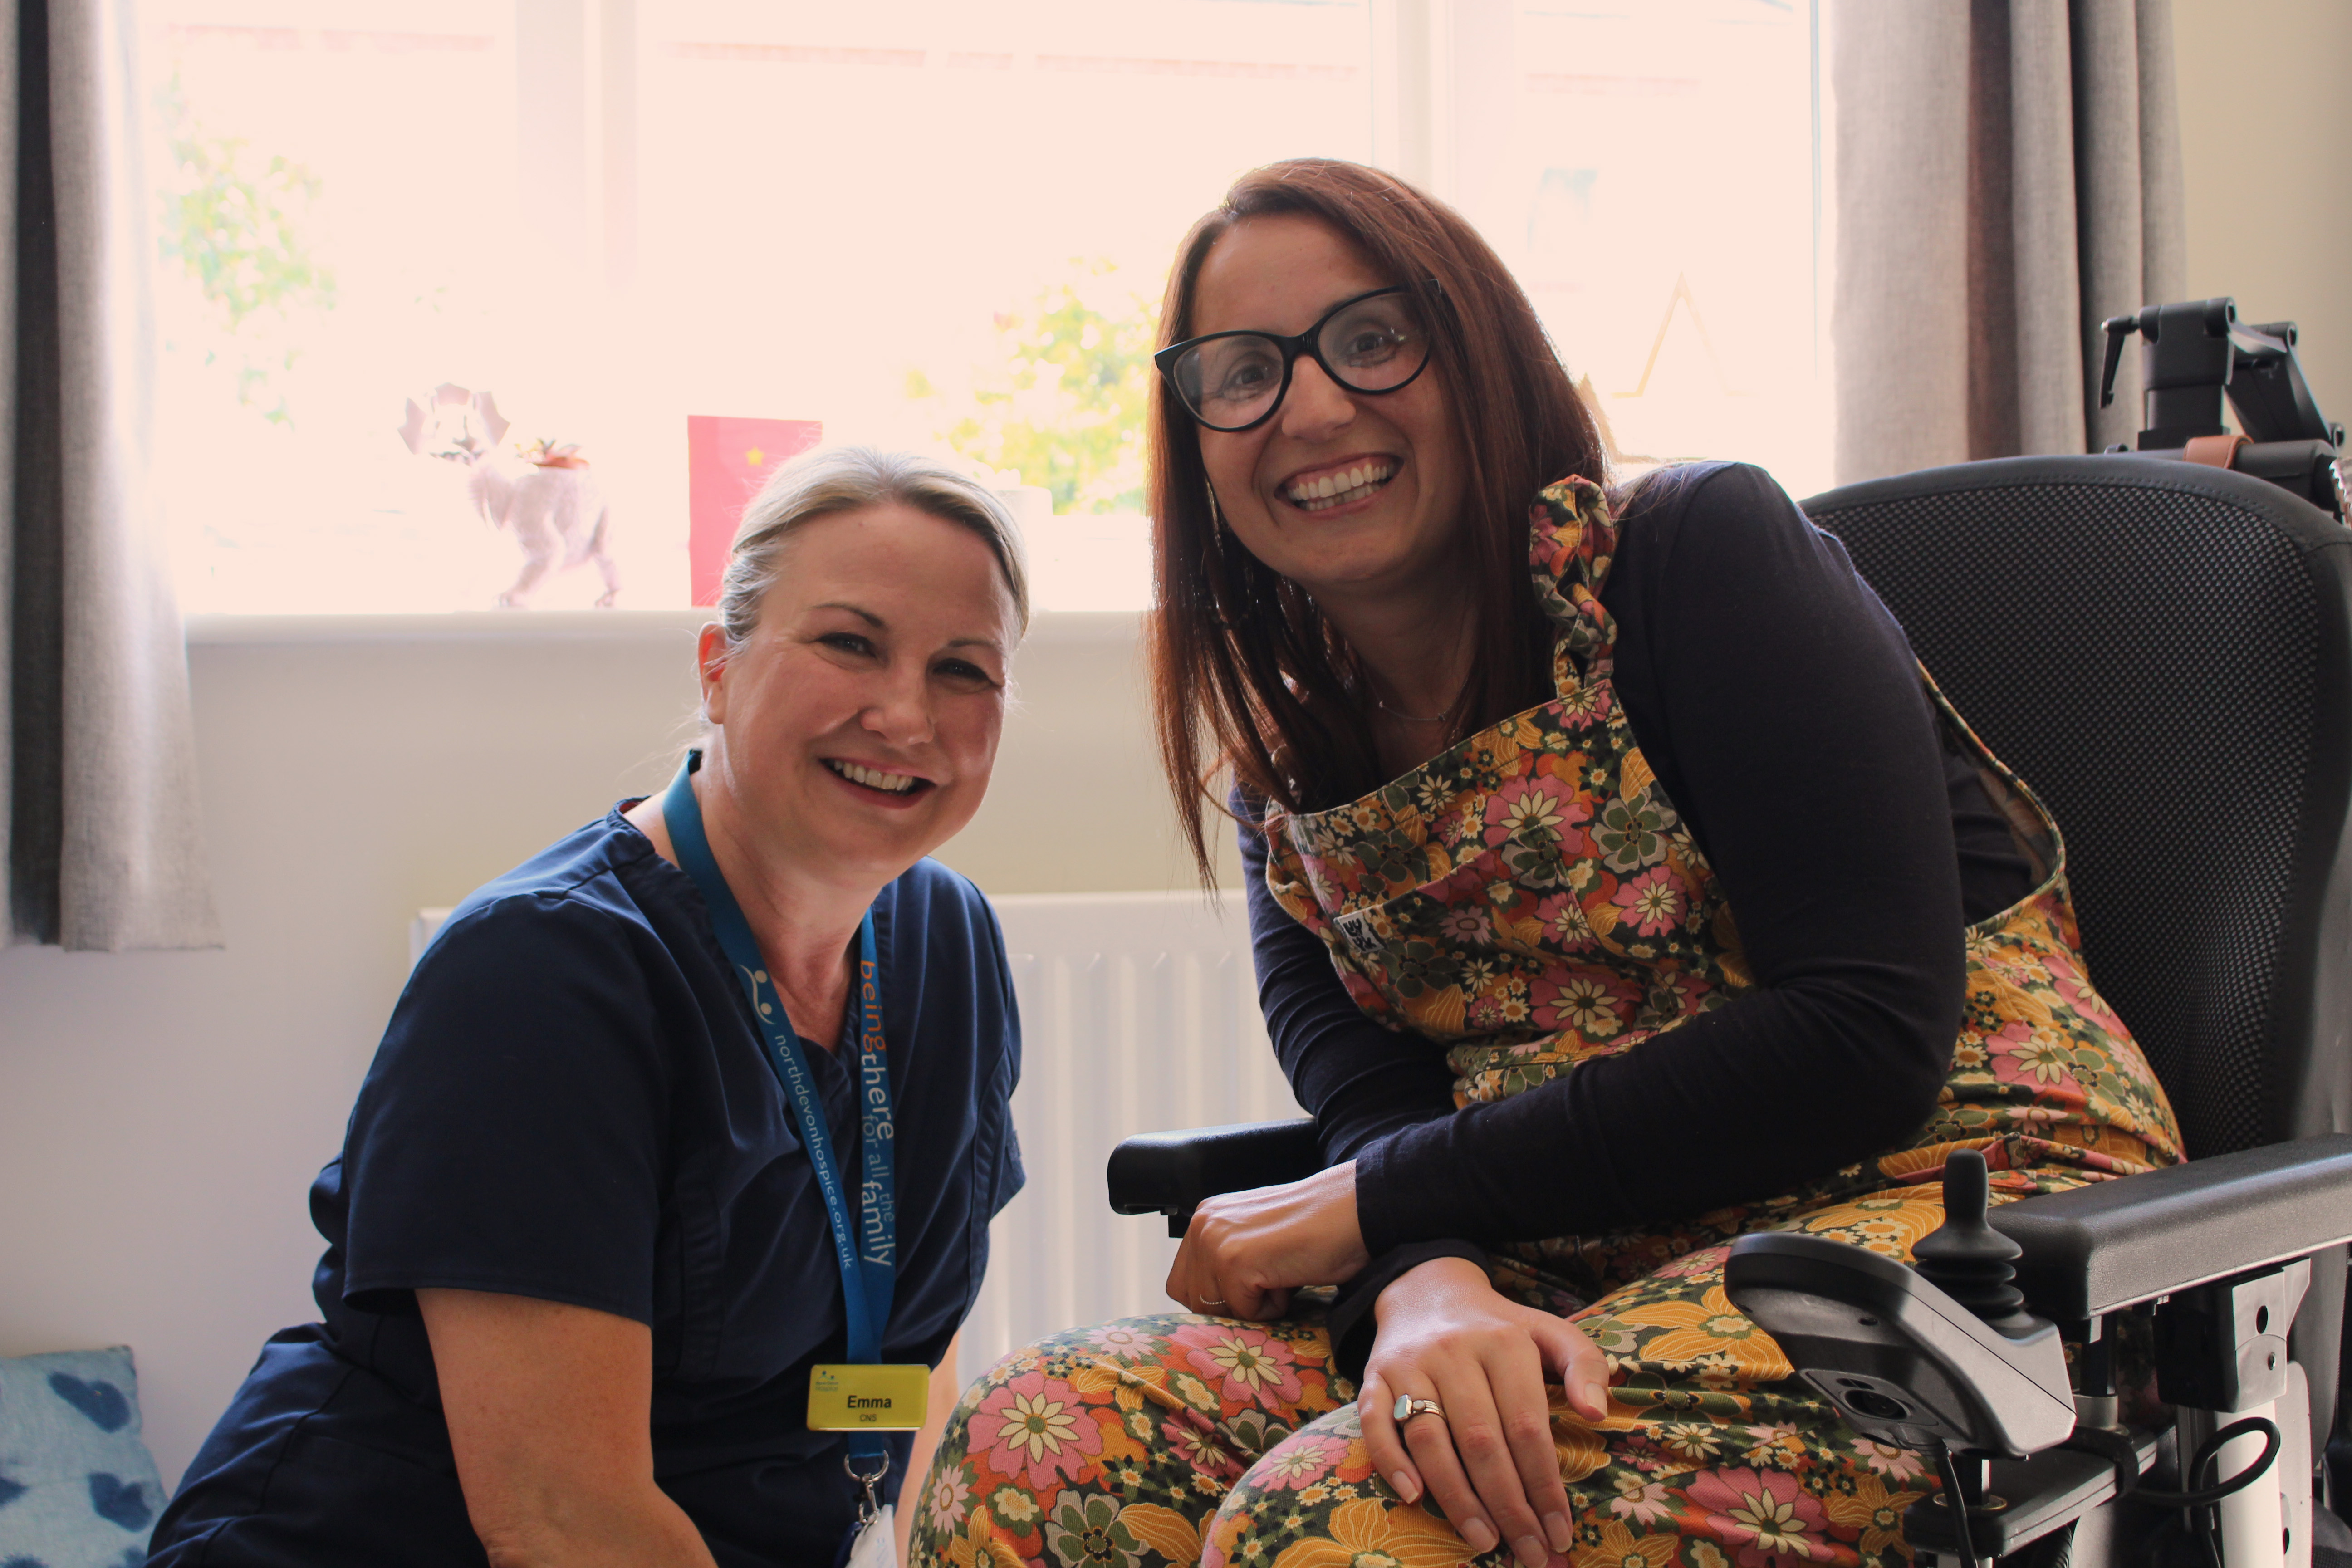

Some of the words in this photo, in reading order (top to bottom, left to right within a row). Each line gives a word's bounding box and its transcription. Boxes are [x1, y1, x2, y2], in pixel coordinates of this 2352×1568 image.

[862, 1114, 879, 1148] for
[775, 1034, 853, 1269] northdevonhospice.org.uk
[868, 1154, 890, 1177] all
[862, 1180, 896, 1266] family
[879, 1193, 895, 1222] the
[847, 1394, 892, 1408] Emma
